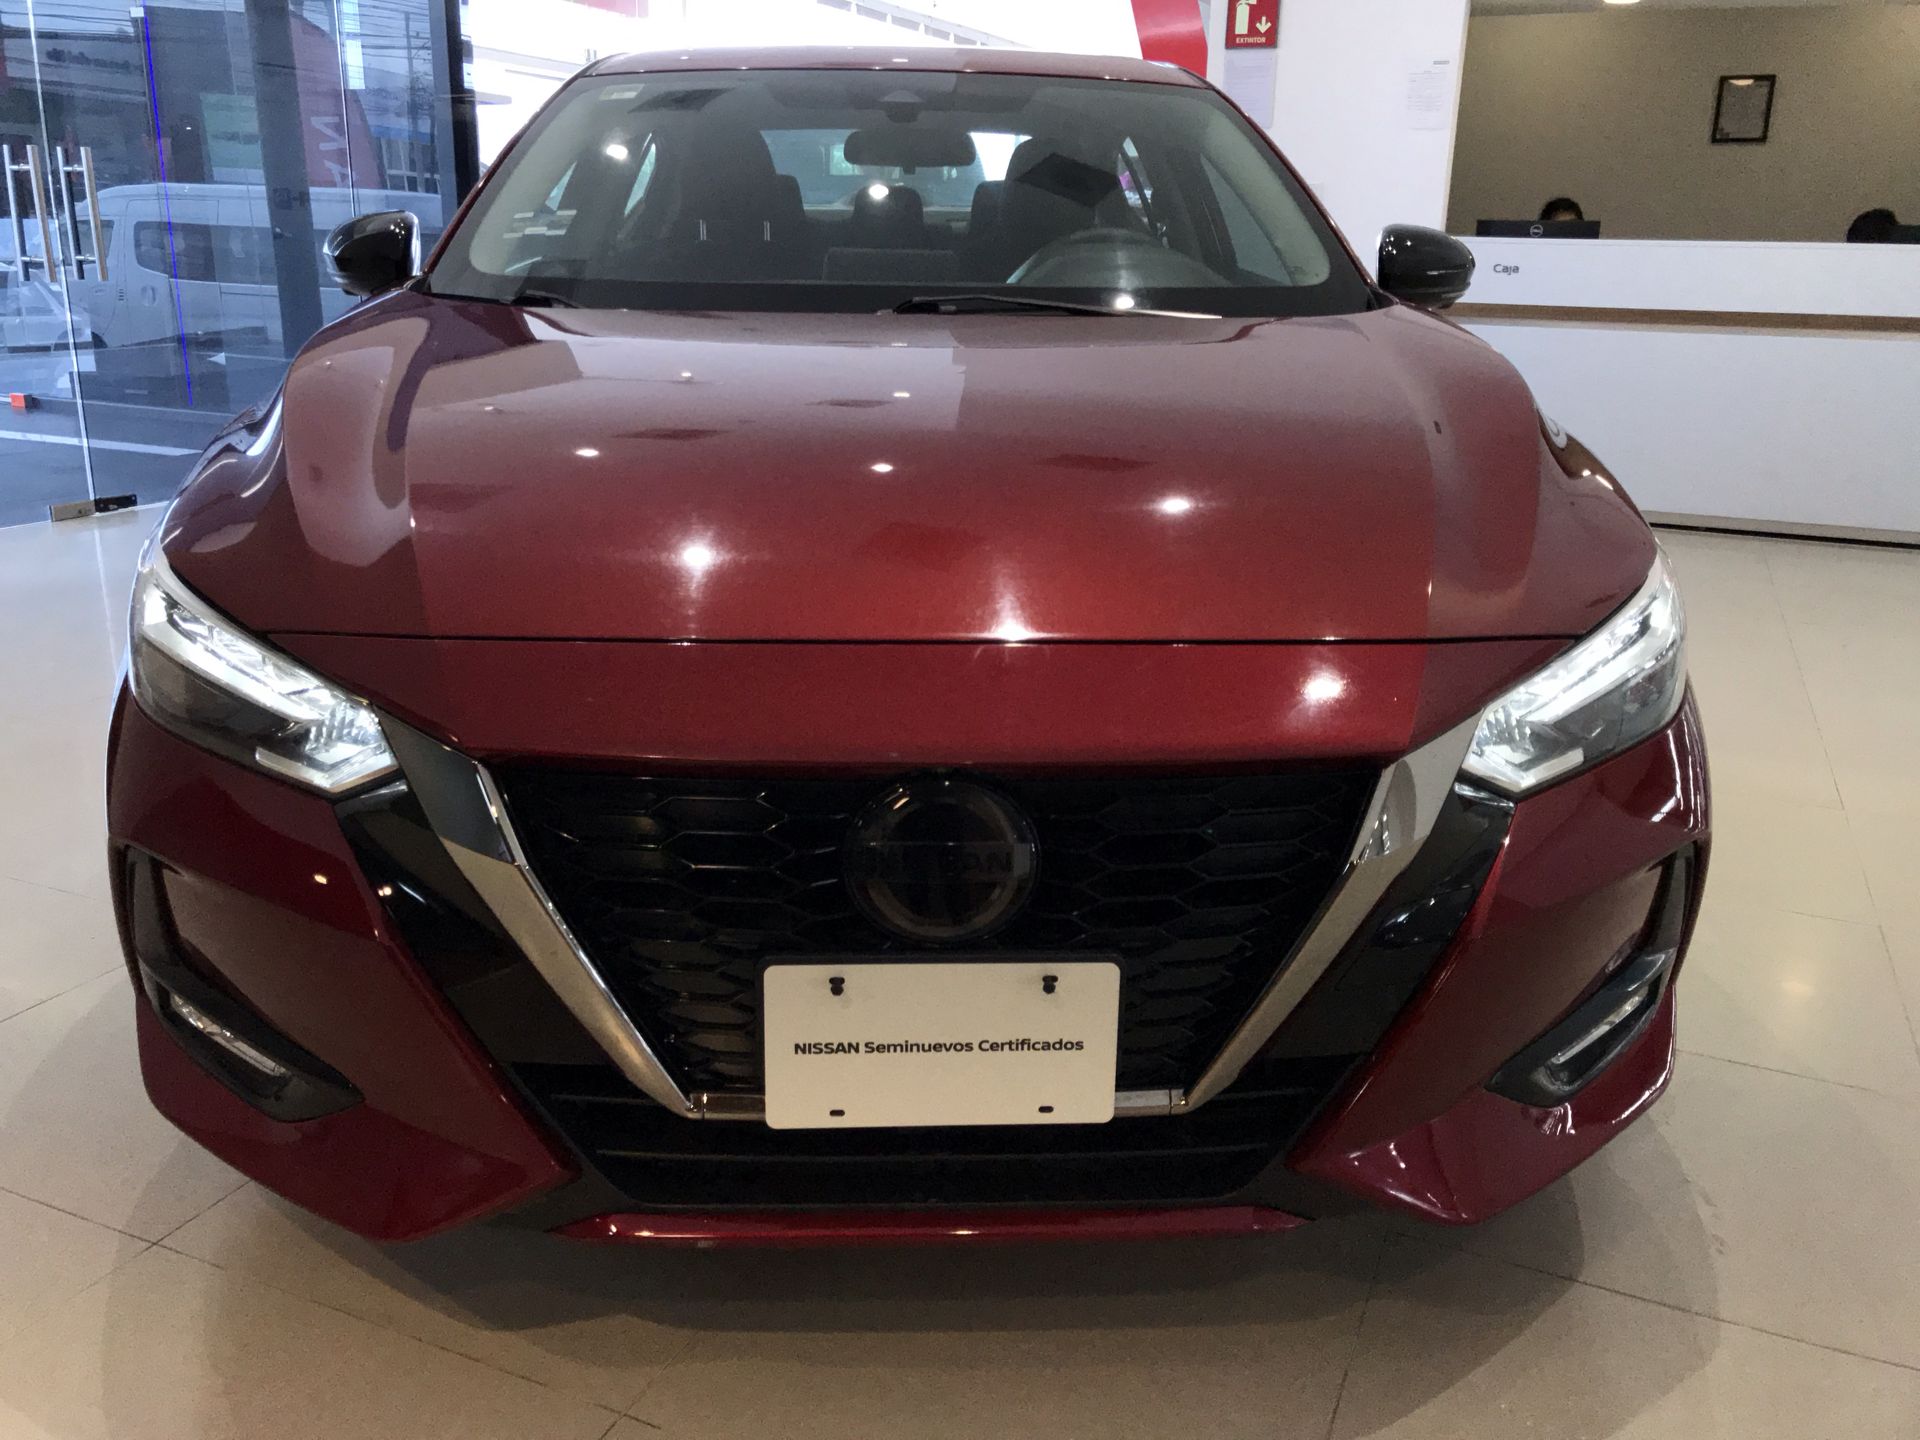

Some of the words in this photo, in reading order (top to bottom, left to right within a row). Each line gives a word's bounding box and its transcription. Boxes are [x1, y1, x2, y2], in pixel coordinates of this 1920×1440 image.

[1493, 263, 1519, 275] Caja
[794, 1042, 860, 1055] NISSAN
[864, 1040, 974, 1053] Seminuevos
[978, 1038, 1084, 1052] Certificados
